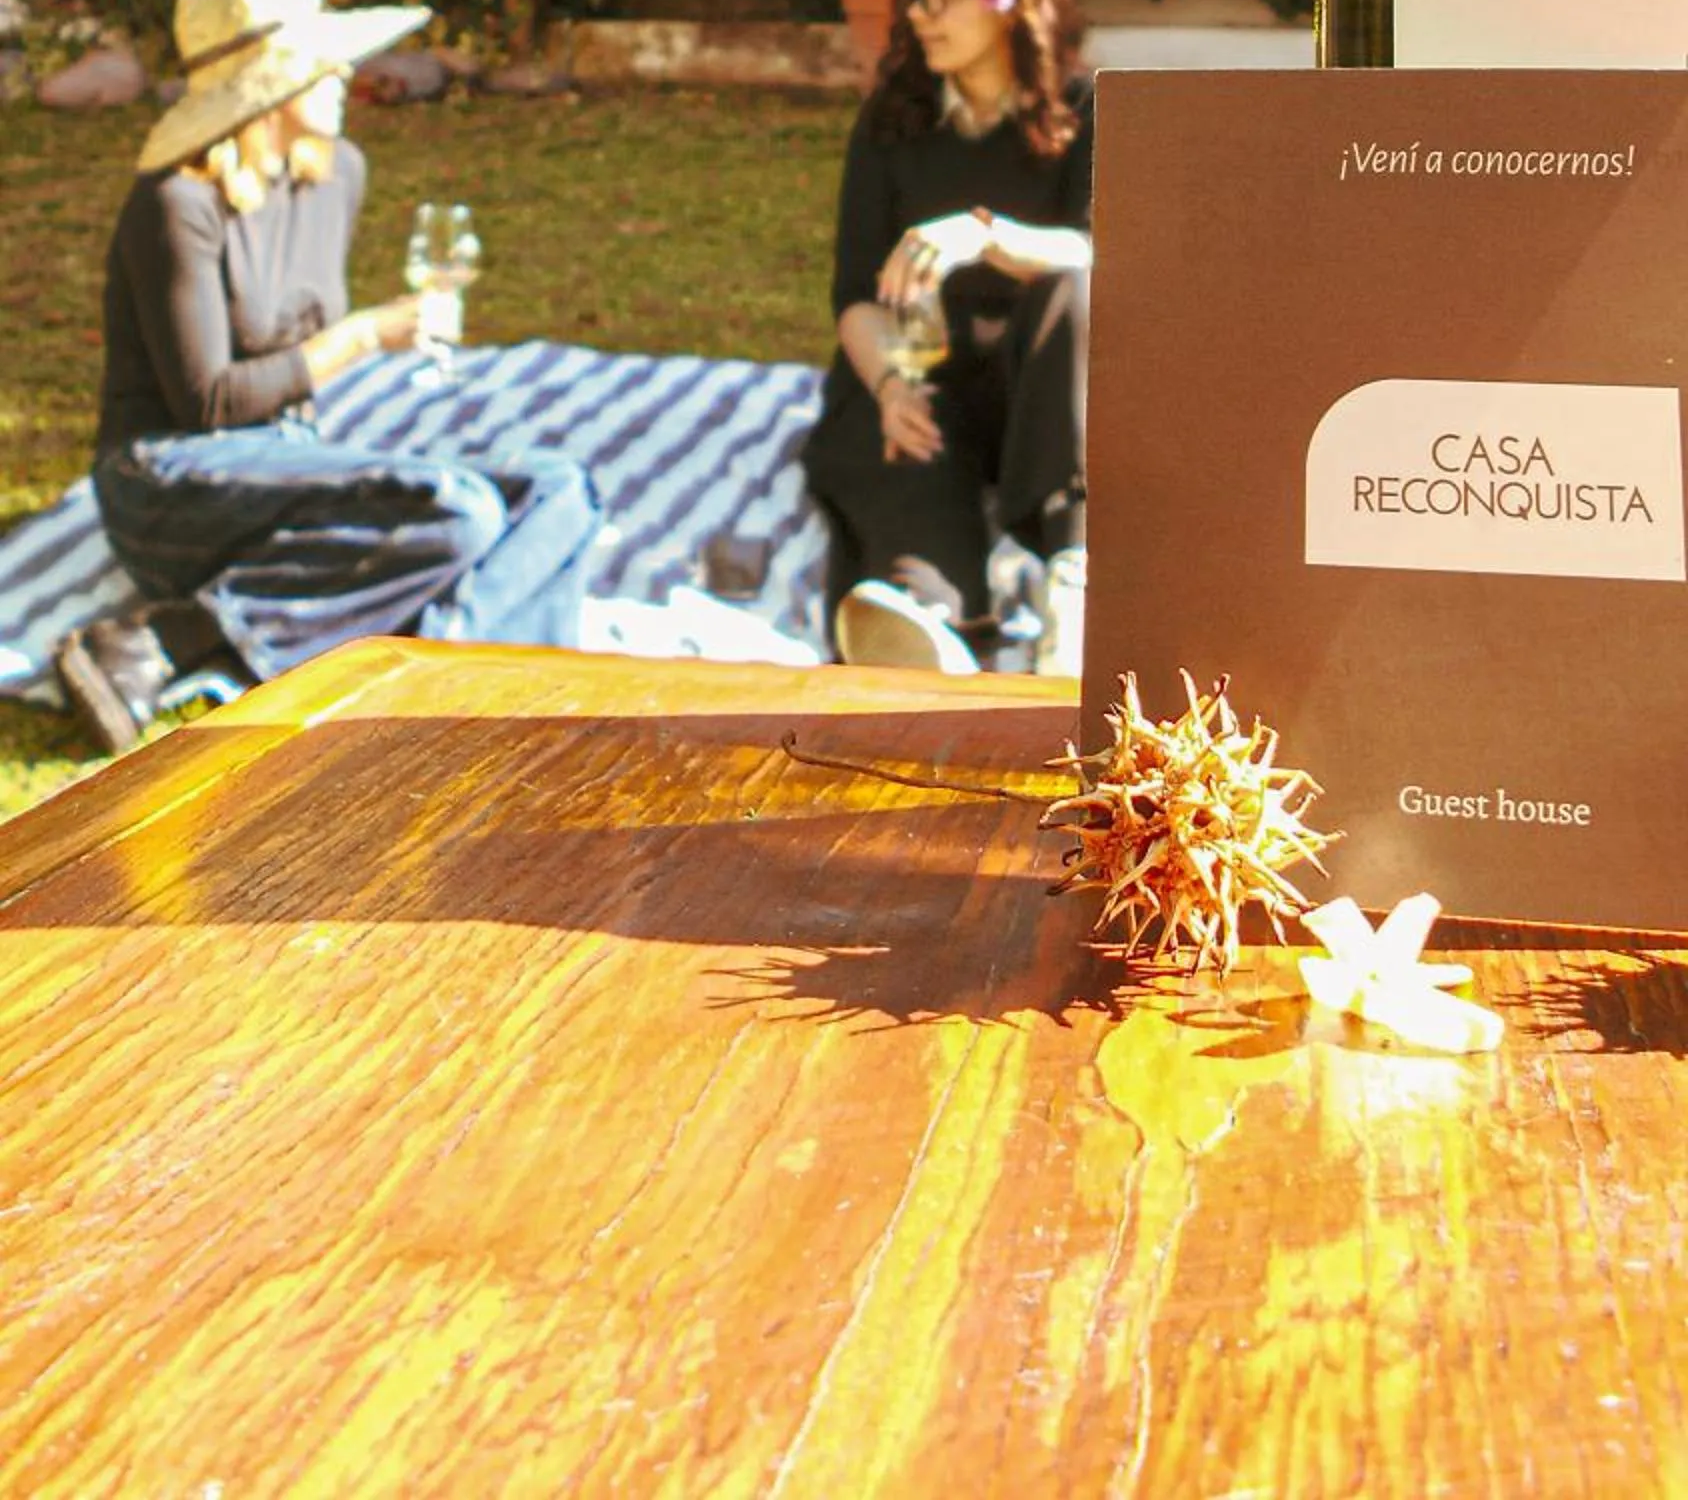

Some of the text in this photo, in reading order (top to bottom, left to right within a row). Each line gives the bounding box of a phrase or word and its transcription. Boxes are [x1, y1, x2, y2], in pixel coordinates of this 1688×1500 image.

[1339, 141, 1636, 181] ¡Vení a conocernos!
[1431, 433, 1555, 476] CASA
[1353, 475, 1654, 523] RECONQUISTA
[1399, 785, 1592, 826] Guest house
